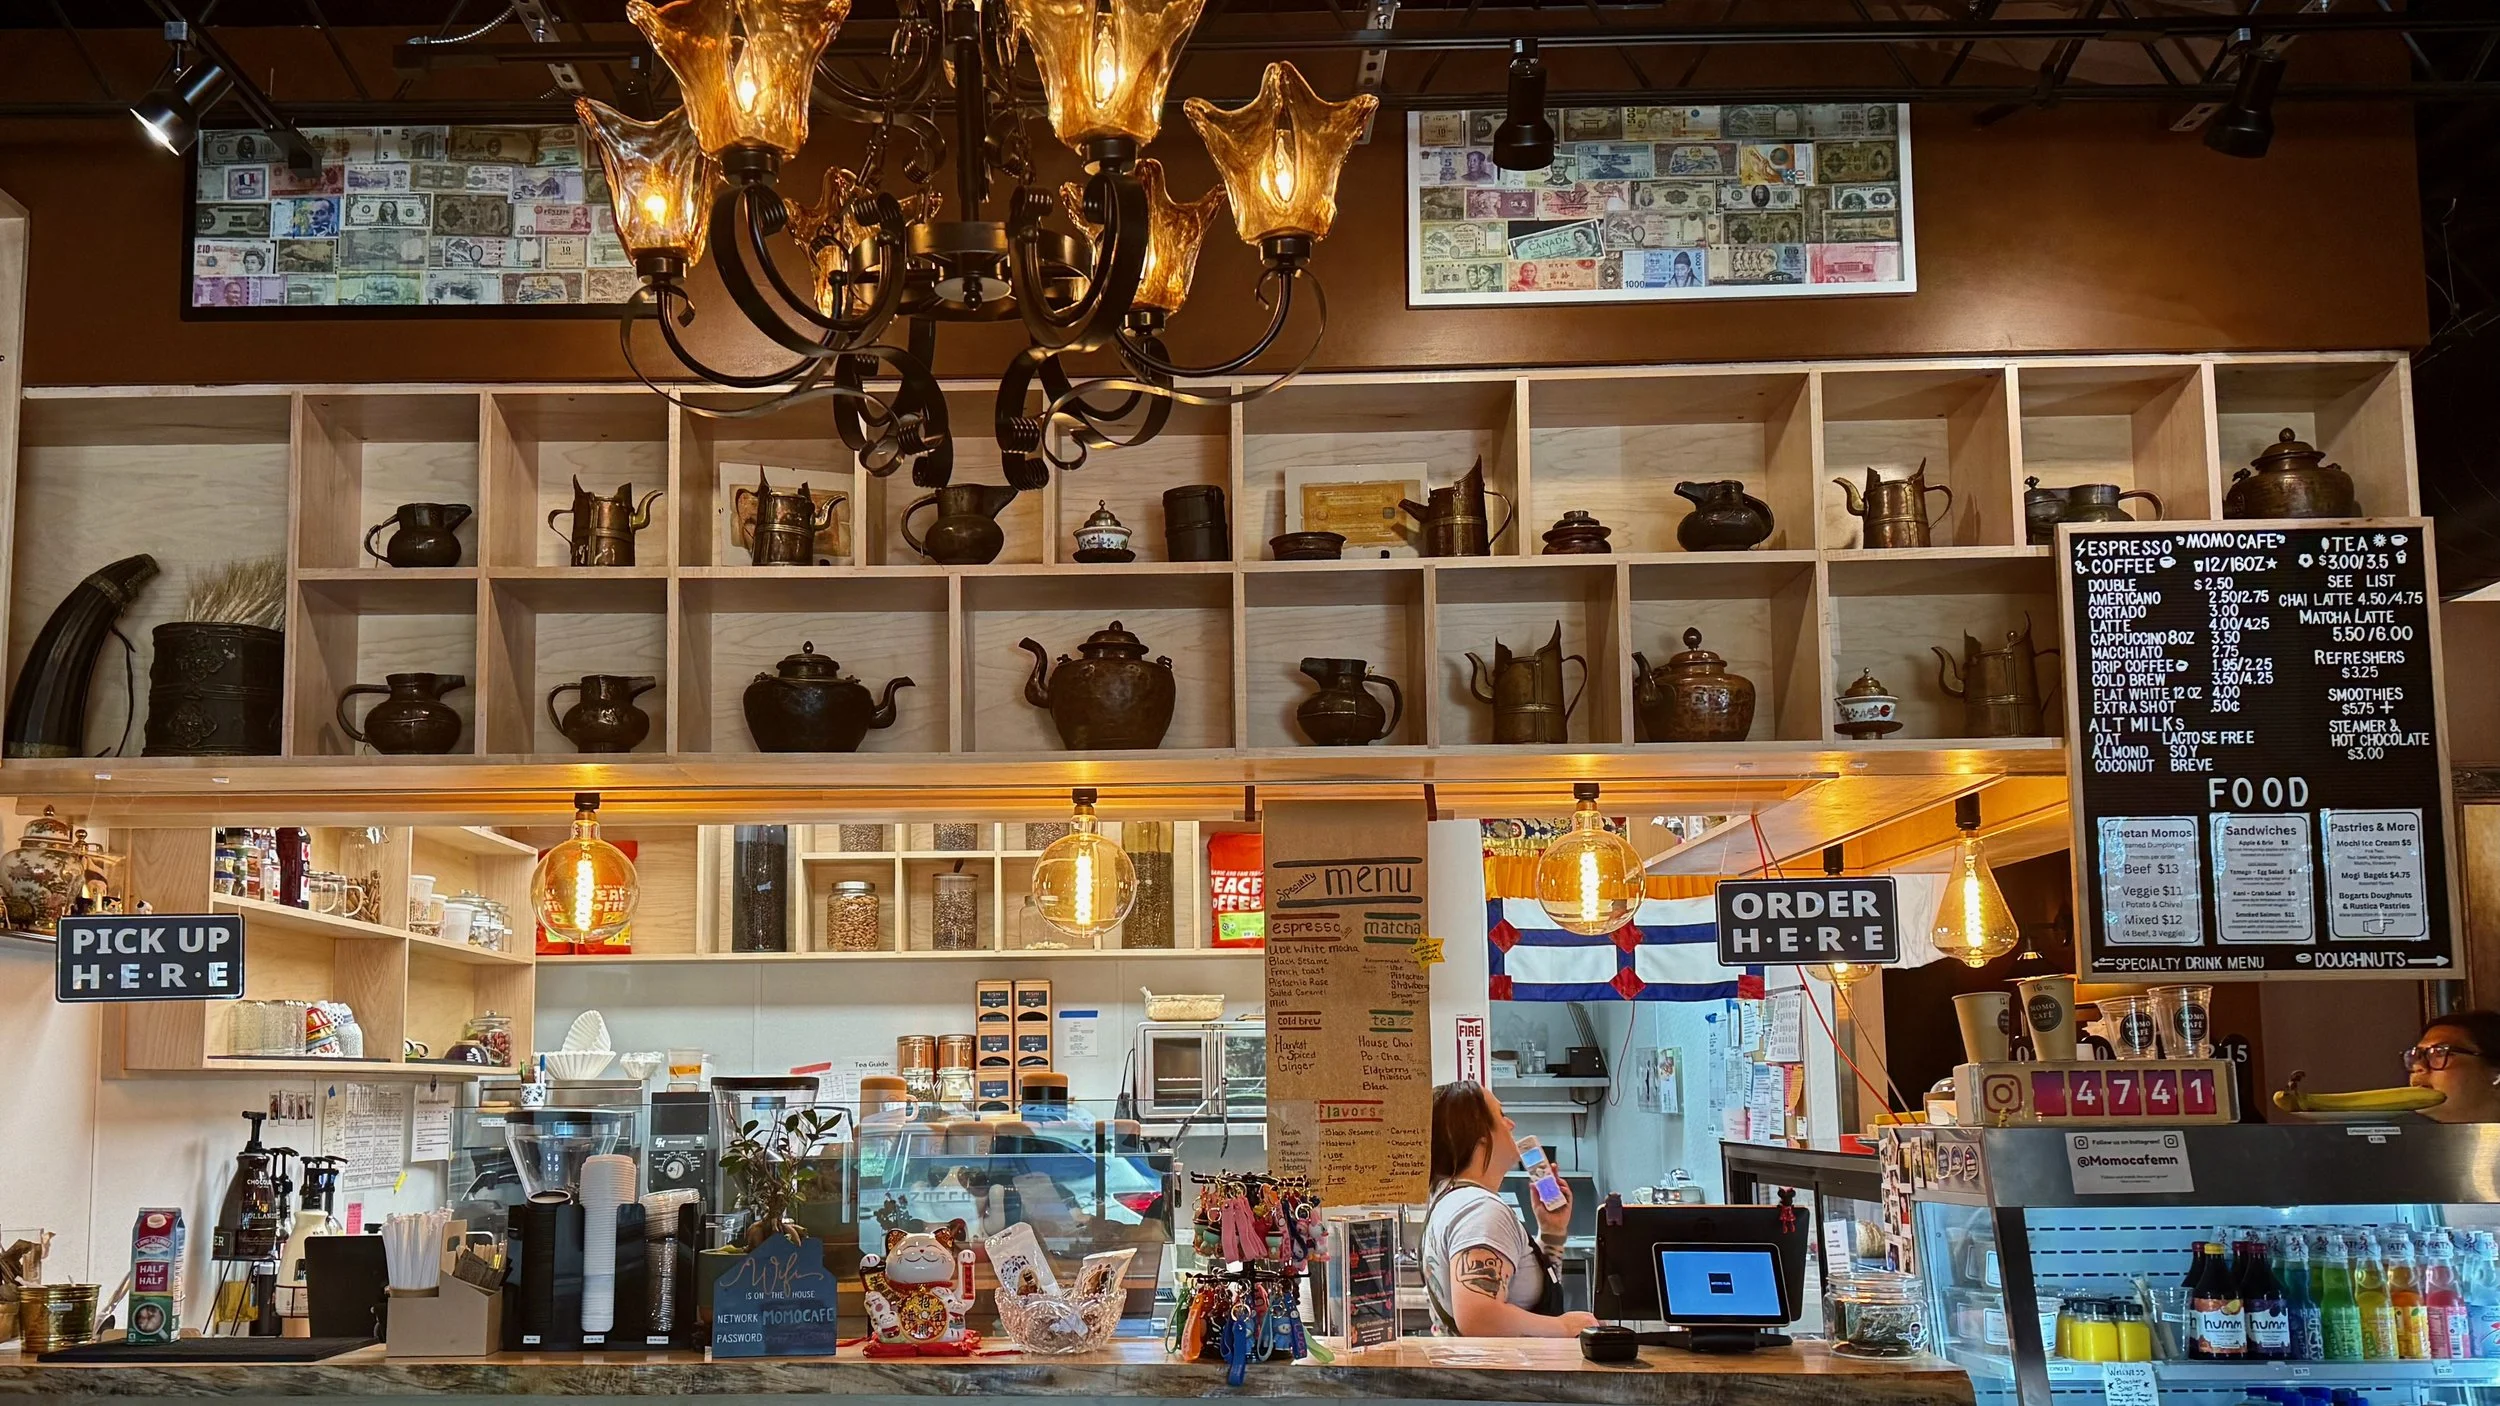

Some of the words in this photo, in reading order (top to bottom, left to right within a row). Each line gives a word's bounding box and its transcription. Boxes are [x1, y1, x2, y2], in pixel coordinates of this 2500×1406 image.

[1528, 235, 1569, 252] CANADA
[1625, 280, 1644, 289] 1000
[2087, 539, 2172, 558] ESPRESSO
[2186, 533, 2234, 549] MOMO
[2237, 533, 2278, 549] CAFE
[2331, 535, 2369, 553] TEA
[2091, 557, 2156, 574] COFFEE
[2088, 578, 2137, 593] DOUBLE
[2327, 574, 2354, 588] SEE
[2367, 574, 2396, 587] LIST
[2088, 591, 2161, 606] AMERICANO
[2208, 590, 2269, 604] 2.50/2.75
[2278, 593, 2308, 608] CHAI
[2313, 593, 2354, 606] LATTE
[2088, 605, 2147, 619] CORTADO
[2208, 603, 2239, 618] 3.00
[2090, 619, 2132, 633] LATTE
[2090, 631, 2167, 646] CAPPUCCINO
[2212, 631, 2241, 645] 3.50
[2091, 646, 2163, 660] MACCHIATO
[2212, 645, 2240, 658] 2.75
[2314, 649, 2405, 665] REFRESHERS
[2092, 659, 2122, 674] DRIP
[2125, 659, 2174, 674] COFFEE
[2212, 658, 2273, 672] 1.95/2.25
[2341, 665, 2379, 679] $3.25
[2091, 673, 2126, 687] COLD
[2129, 673, 2166, 687] BREW
[2211, 671, 2274, 686] 3.50/4.25
[2094, 687, 2122, 701] FLAT
[2128, 687, 2170, 701] WHITE
[2173, 687, 2184, 700] 12
[2187, 686, 2203, 699] OZ
[2212, 686, 2241, 699] 4.00
[2327, 686, 2404, 701] SMOOTHIES
[2093, 700, 2137, 715] EXTRA
[2139, 699, 2177, 714] SHOT
[2342, 702, 2375, 716] $5.75
[2088, 716, 2125, 733] ALT
[2328, 719, 2387, 733] STEAMER
[2389, 718, 2402, 733] &
[2095, 732, 2121, 747] OAT
[2162, 731, 2218, 745] LACTOSE
[2221, 731, 2255, 745] FREE
[2331, 733, 2356, 747] HOT
[2359, 732, 2430, 746] CHOCOLATE
[2091, 746, 2149, 760] ALMOND
[2169, 745, 2197, 758] SOY
[2347, 746, 2384, 761] $3.00
[2095, 759, 2155, 773] COCONUT
[2170, 758, 2214, 772] BREVE
[2208, 776, 2309, 808] FOOD
[2151, 828, 2193, 838] Momos
[2226, 825, 2297, 836] Sandwiches
[2330, 822, 2374, 832] Pastries
[2376, 822, 2386, 832] &
[2387, 822, 2416, 832] More
[2336, 839, 2361, 847] Mochi
[2362, 839, 2374, 847] Ice
[2375, 839, 2400, 847] Cream
[2401, 839, 2412, 847] $5
[2124, 864, 2151, 875] Beef
[2157, 863, 2179, 875] $13
[2341, 872, 2360, 881] Mogi
[2363, 872, 2389, 881] Bagels
[2389, 871, 2411, 880] $4.75
[1211, 876, 1263, 895] EACE
[1276, 872, 1317, 902] Specialty
[1325, 866, 1412, 896] menu
[2122, 886, 2159, 898] Veggie
[2162, 886, 2183, 897] $11
[2339, 892, 2369, 901] Bogarts
[2370, 892, 2412, 901] Doughnuts
[1731, 890, 1881, 920] ORDER
[2350, 902, 2378, 910] Rustica
[2379, 902, 2411, 910] Pastries
[2124, 914, 2159, 925] Mixed
[2162, 914, 2183, 926] $12
[1272, 922, 1341, 936] espresso
[1364, 921, 1421, 935] matcha
[72, 927, 166, 955] PICK
[178, 927, 231, 953] UP
[2116, 957, 2182, 971] SPECIALTY
[2185, 956, 2223, 970] DRINK
[2227, 955, 2265, 969] MENU
[2315, 952, 2406, 968] DOUGHNUTS
[1277, 1016, 1297, 1026] cold
[1299, 1016, 1321, 1026] brew
[1372, 1016, 1395, 1027] tea
[1459, 1025, 1481, 1037] FIRE
[1358, 1035, 1389, 1048] House
[1392, 1036, 1413, 1048] Chai
[868, 1060, 889, 1068] Guide
[1277, 1056, 1315, 1075] Ginger
[1320, 1104, 1377, 1119] flavors
[2077, 1154, 2179, 1168] @Momocafemn
[140, 1265, 165, 1274] HALF
[139, 1276, 164, 1285] HALF
[745, 1292, 752, 1300] IS
[754, 1292, 764, 1300] ON
[771, 1291, 785, 1300] THE
[792, 1290, 815, 1299] HOUSE
[717, 1313, 759, 1324] NETWORK
[763, 1307, 835, 1326] MOMOCAFE
[2204, 1314, 2243, 1331] humm
[2249, 1314, 2287, 1331] humm
[716, 1333, 762, 1344] PASSWORD
